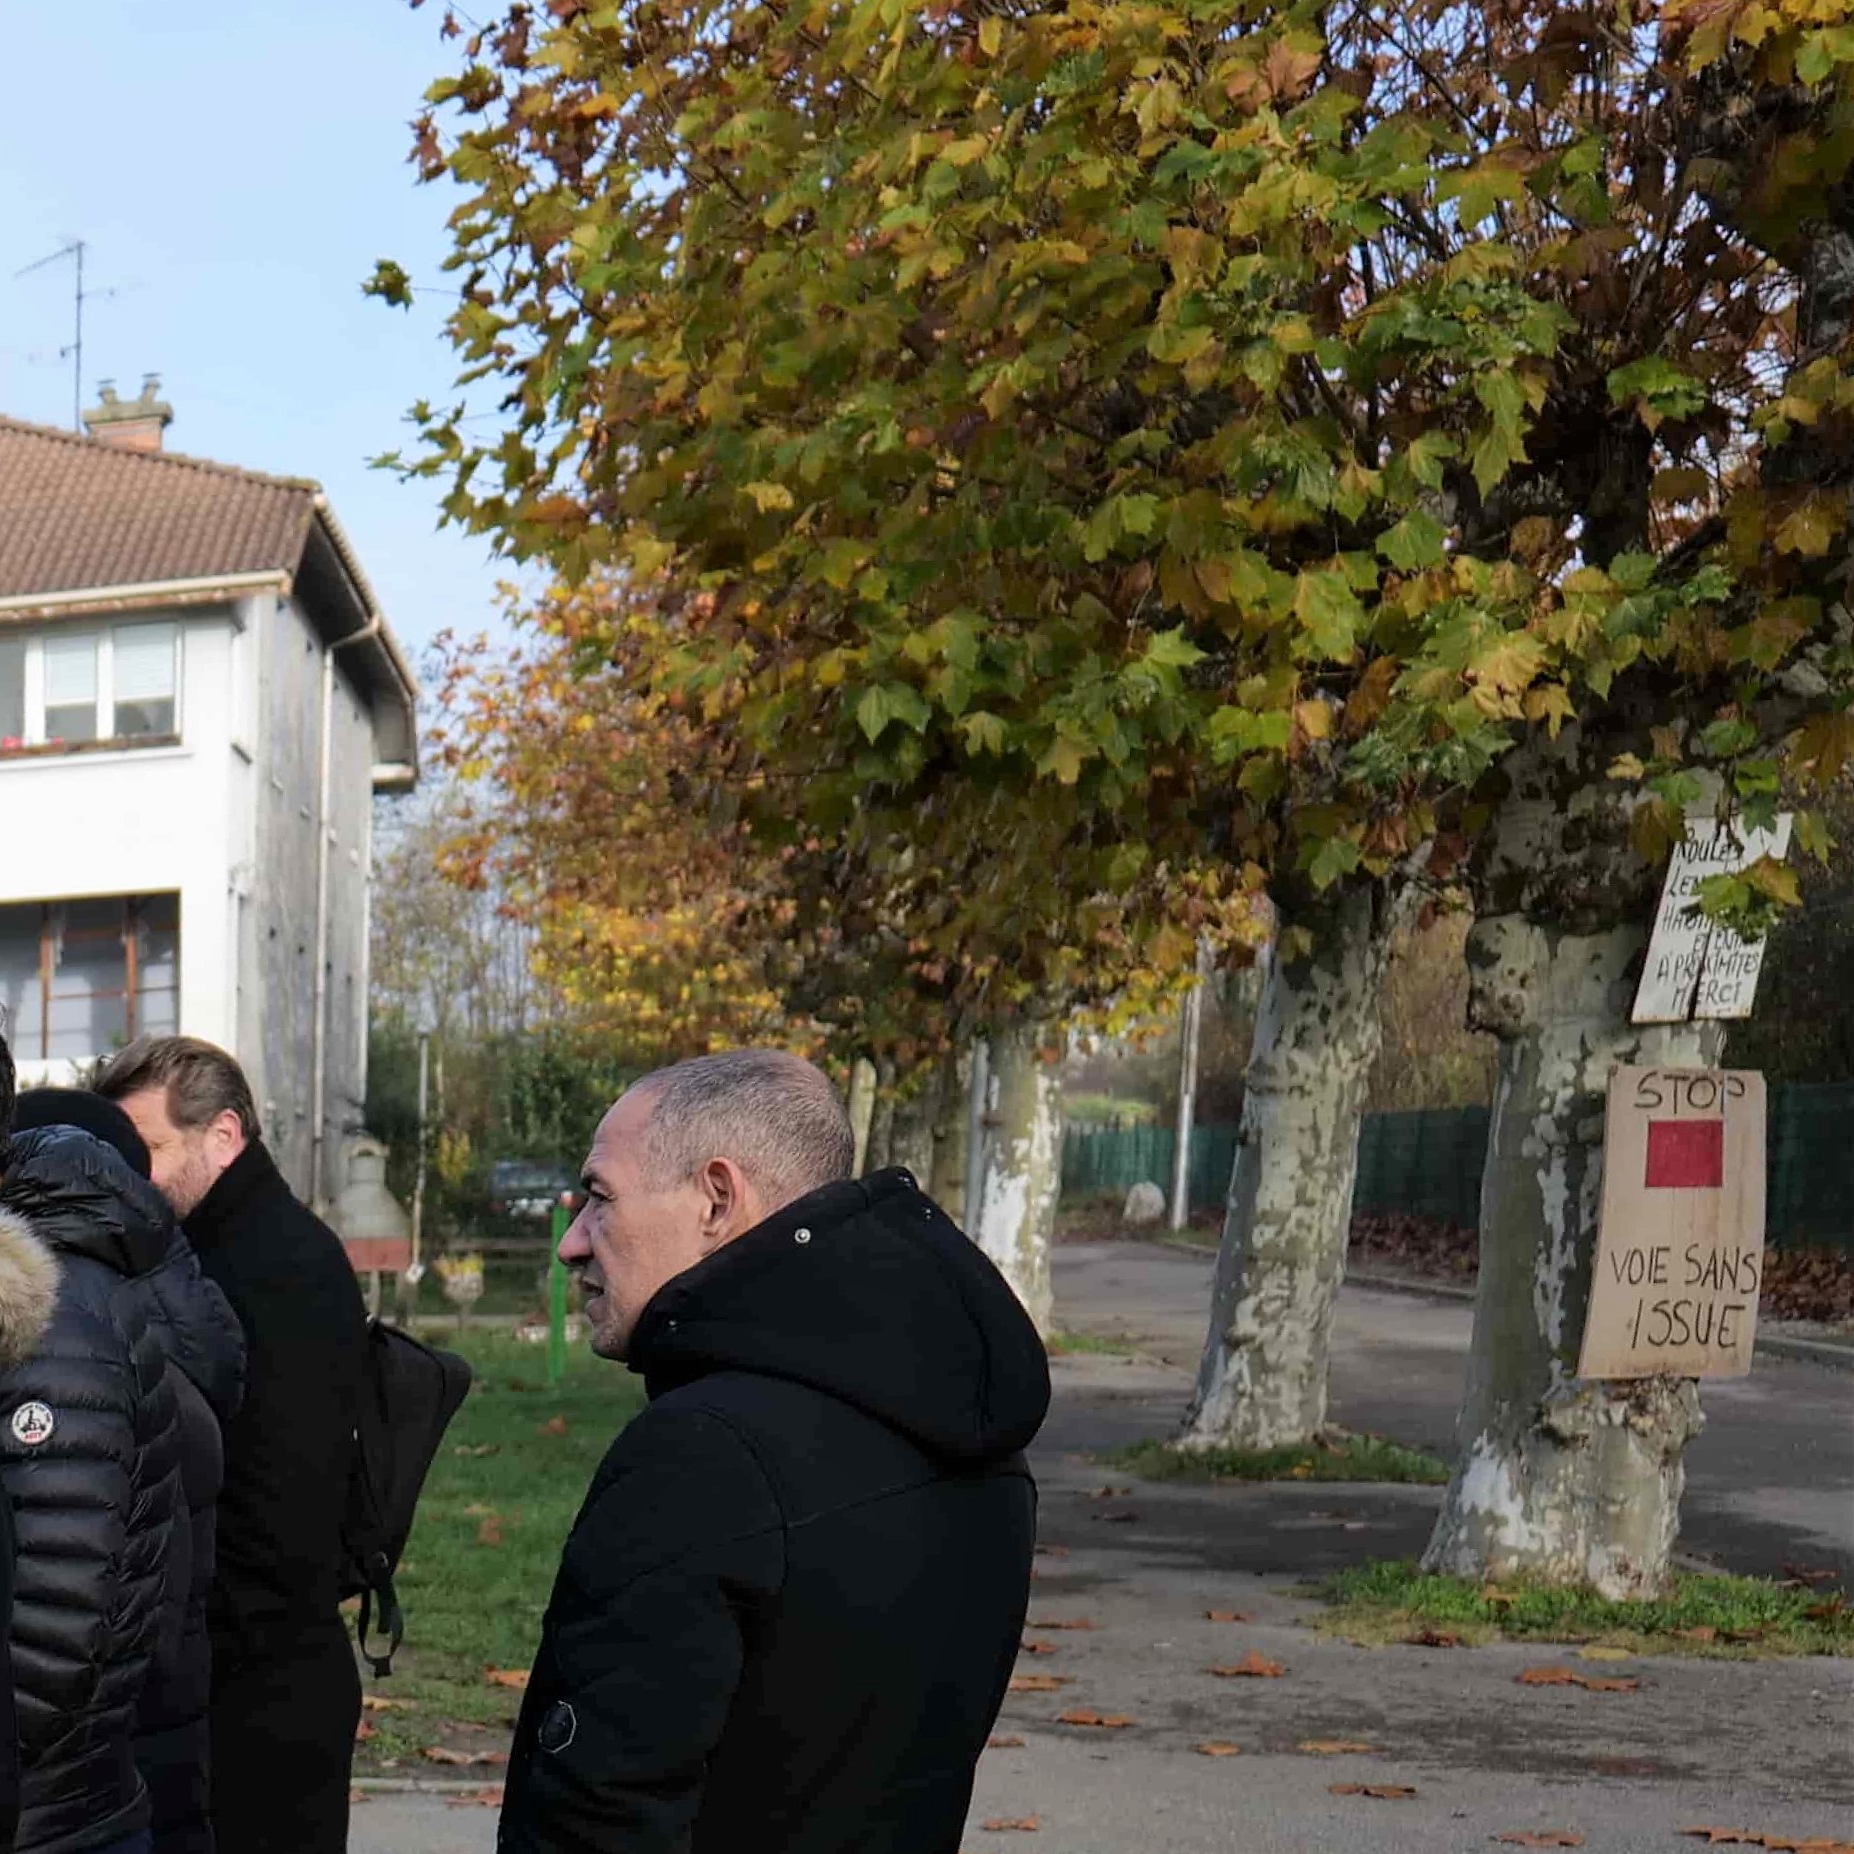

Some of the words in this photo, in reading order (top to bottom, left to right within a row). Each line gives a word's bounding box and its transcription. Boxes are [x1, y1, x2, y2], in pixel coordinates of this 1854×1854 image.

[1634, 1070, 1745, 1115] STOP
[1611, 1246, 1670, 1285] VOIE
[1684, 1242, 1758, 1295] SANS
[1631, 1299, 1746, 1349] ISSUE
